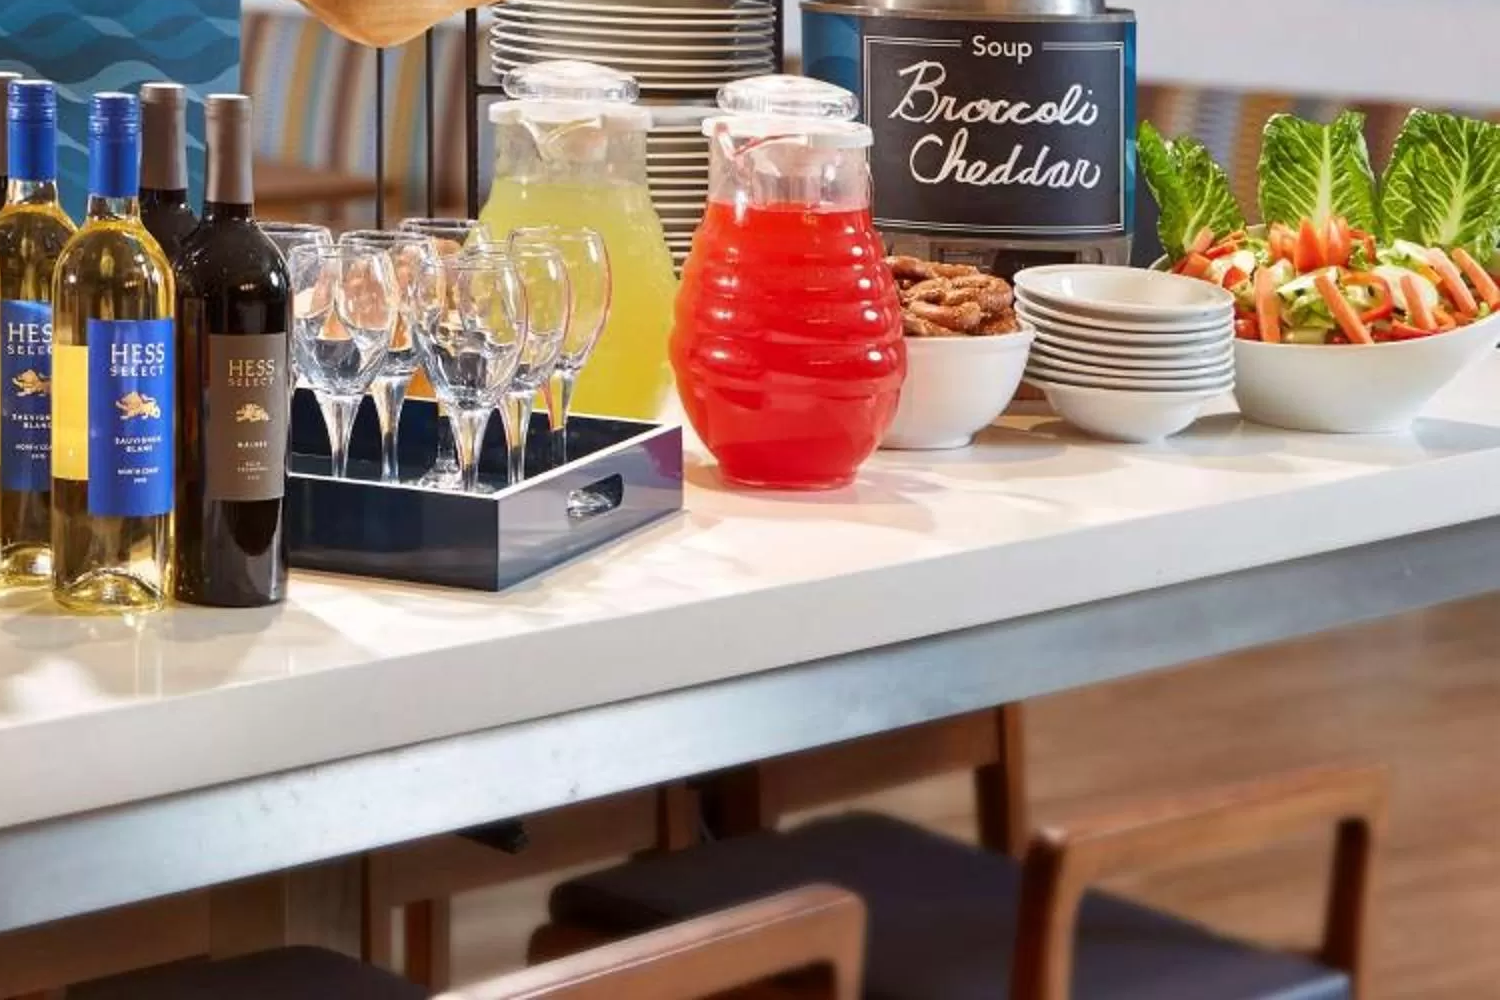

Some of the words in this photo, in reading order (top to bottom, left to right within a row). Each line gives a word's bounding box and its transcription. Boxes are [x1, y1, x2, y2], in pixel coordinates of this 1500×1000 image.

[972, 35, 1033, 64] Soup
[888, 60, 1100, 126] Broccoli
[909, 128, 1101, 188] Cheddar
[7, 322, 52, 343] HES
[6, 345, 52, 356] SELEC
[111, 343, 165, 365] HESS
[109, 365, 165, 377] SELECT
[228, 359, 276, 377] HESS
[227, 377, 275, 387] SELECT
